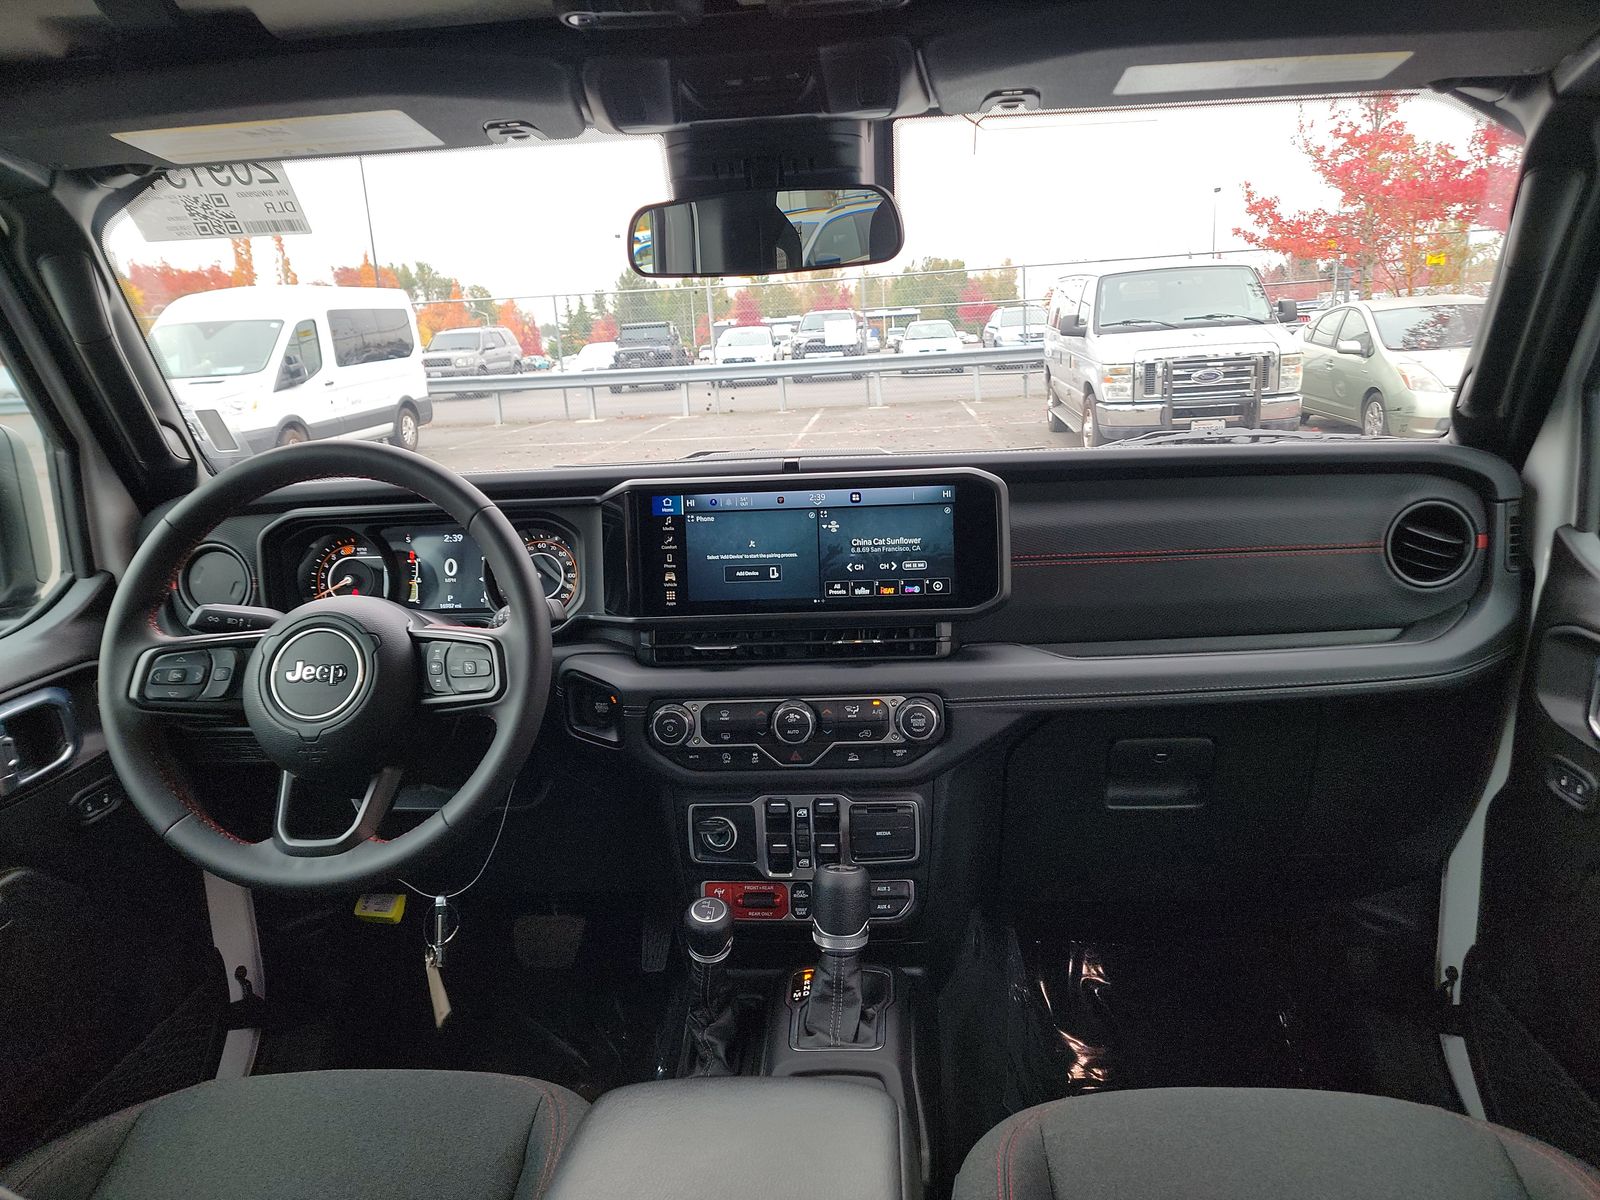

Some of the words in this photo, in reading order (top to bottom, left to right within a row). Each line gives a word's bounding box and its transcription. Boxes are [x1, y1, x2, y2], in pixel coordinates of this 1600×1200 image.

[942, 490, 952, 498] HI
[444, 534, 463, 542] 2:39
[886, 537, 922, 545] Sunflower
[444, 558, 458, 577] 0
[285, 660, 347, 684] Jeep
